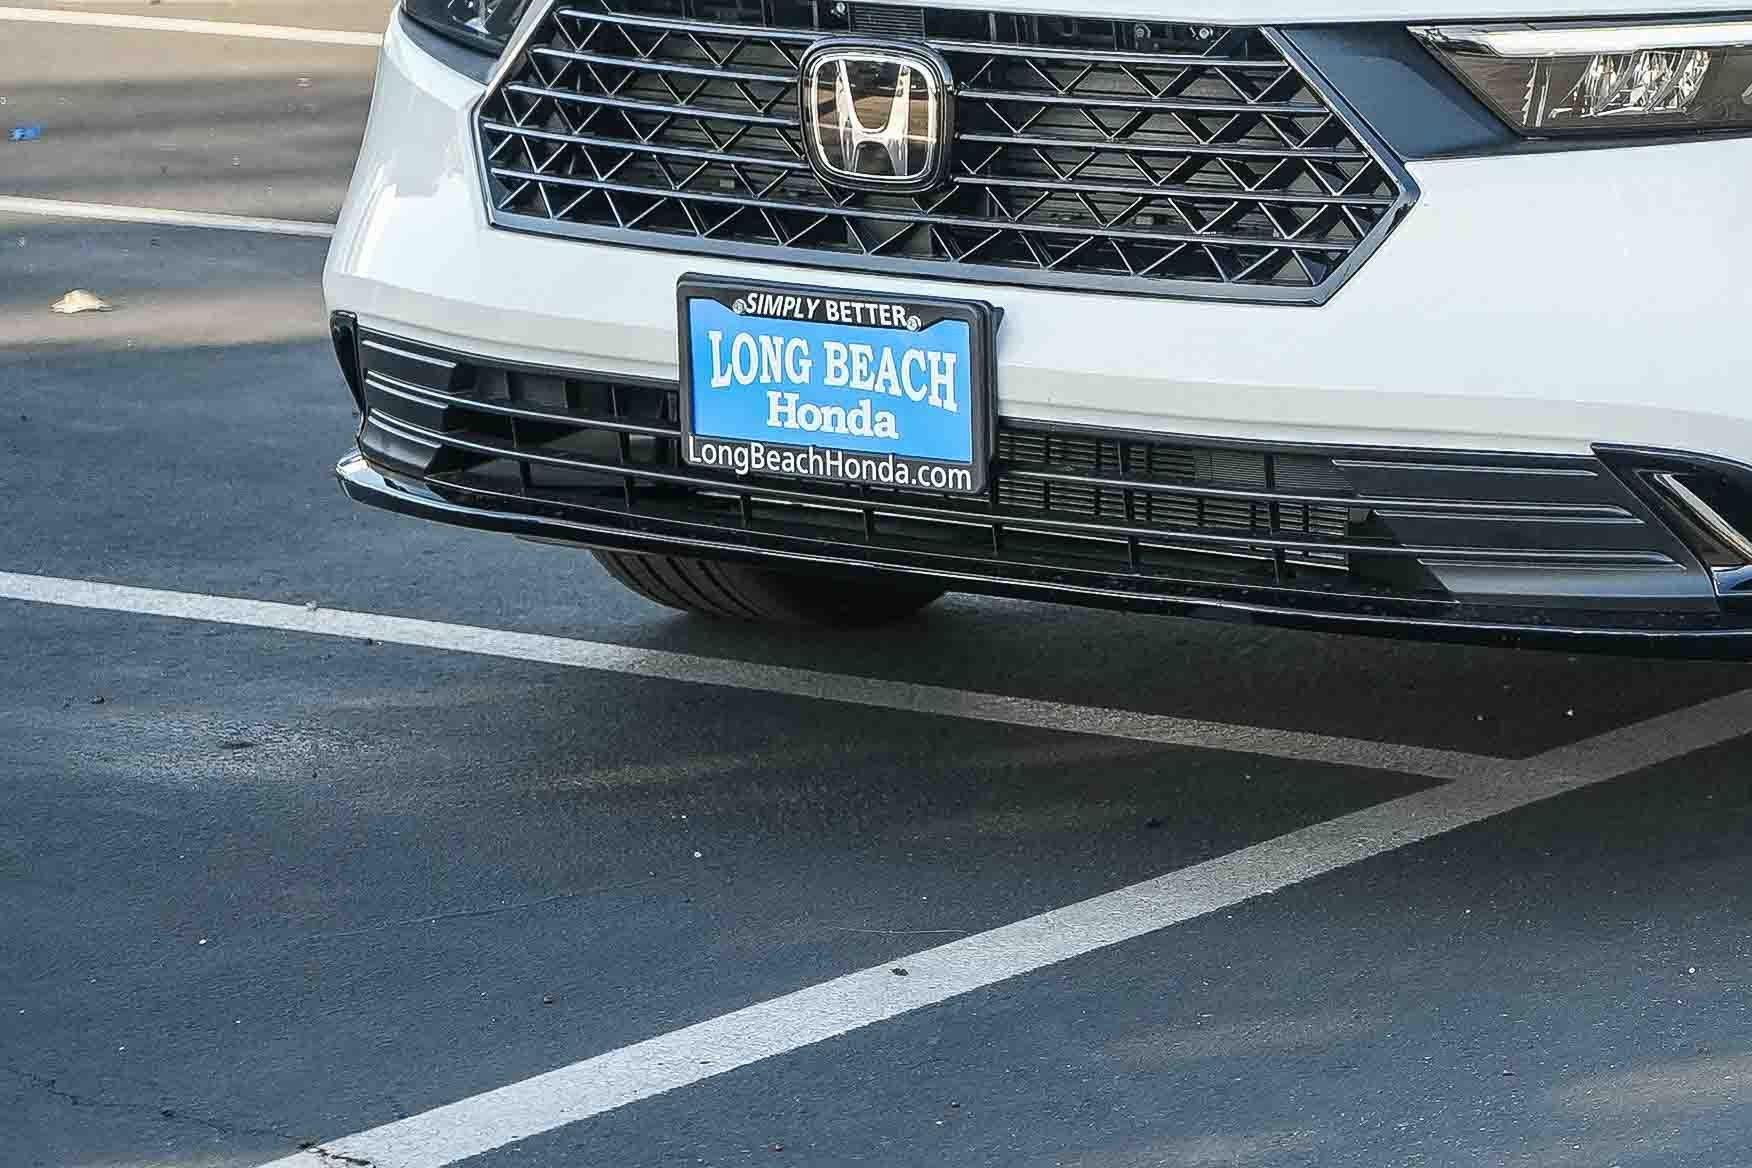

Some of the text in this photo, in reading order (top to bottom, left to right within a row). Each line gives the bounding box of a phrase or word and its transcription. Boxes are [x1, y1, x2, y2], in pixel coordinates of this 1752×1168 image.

[745, 293, 907, 328] SIMPLY BETTER
[708, 330, 958, 413] LONG BEACH
[766, 391, 900, 440] Honda
[688, 436, 972, 491] LongBeachHonda.com
